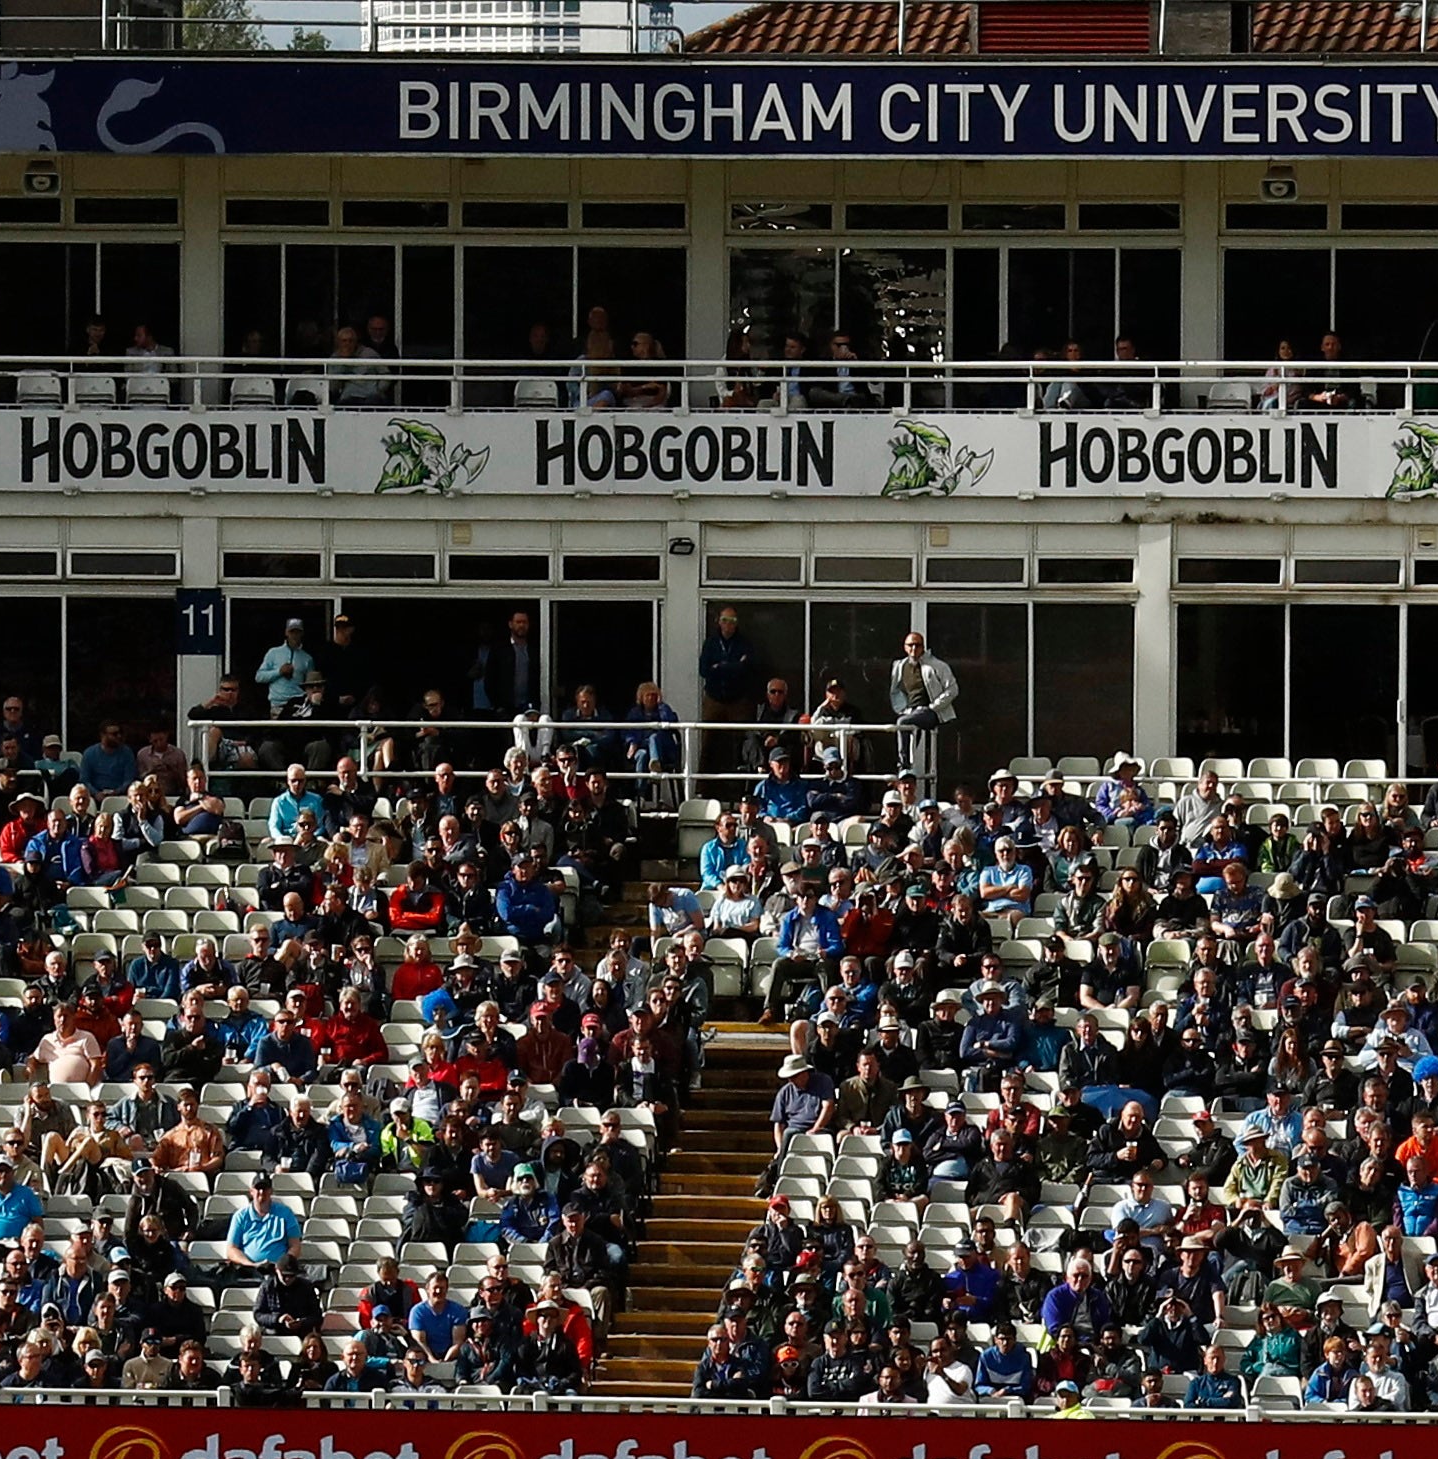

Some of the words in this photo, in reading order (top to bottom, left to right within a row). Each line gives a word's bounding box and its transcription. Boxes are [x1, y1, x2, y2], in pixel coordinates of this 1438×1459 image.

[400, 82, 851, 140] BIRMINGHAM
[881, 84, 1030, 141] CITY
[20, 416, 326, 484] HOBGOBLIN
[536, 419, 834, 487] HOBGOBLIN
[1039, 422, 1338, 488] HOBGOBLIN
[183, 605, 213, 635] 11
